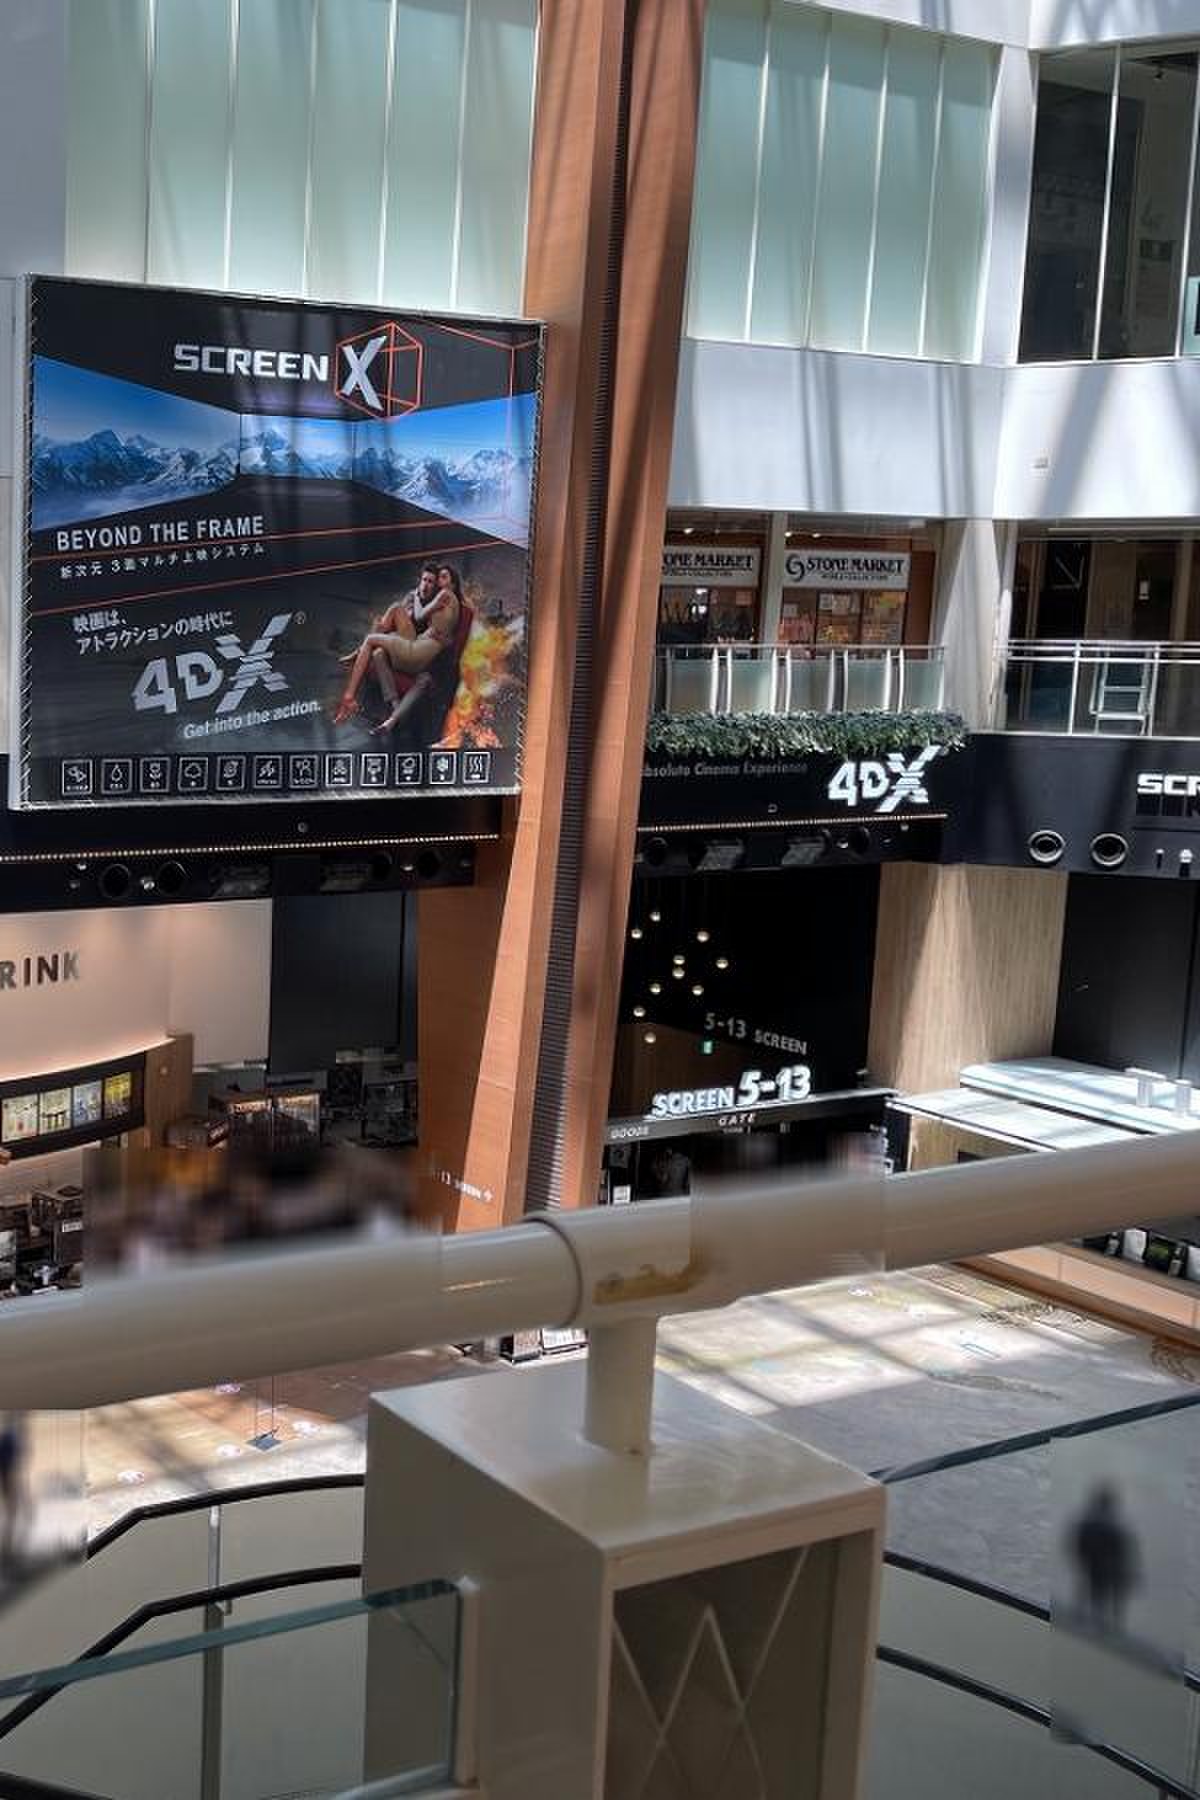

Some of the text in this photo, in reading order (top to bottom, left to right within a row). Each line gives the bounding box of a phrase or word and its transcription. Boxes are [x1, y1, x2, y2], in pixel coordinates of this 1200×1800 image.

[173, 344, 328, 382] SCREEN
[56, 515, 264, 551] BEYOND THE FRAME
[694, 553, 752, 568] MARKET
[806, 557, 905, 574] STONE MARKET
[77, 611, 233, 655] アトラクションの時代に
[132, 613, 293, 714] 4DX
[183, 720, 212, 740] Get
[214, 715, 243, 734] into
[247, 708, 271, 727] the
[828, 745, 941, 813] 4DX
[705, 1013, 808, 1056] 5-13 SCREEN
[651, 1065, 811, 1117] SCREEN 5-13
